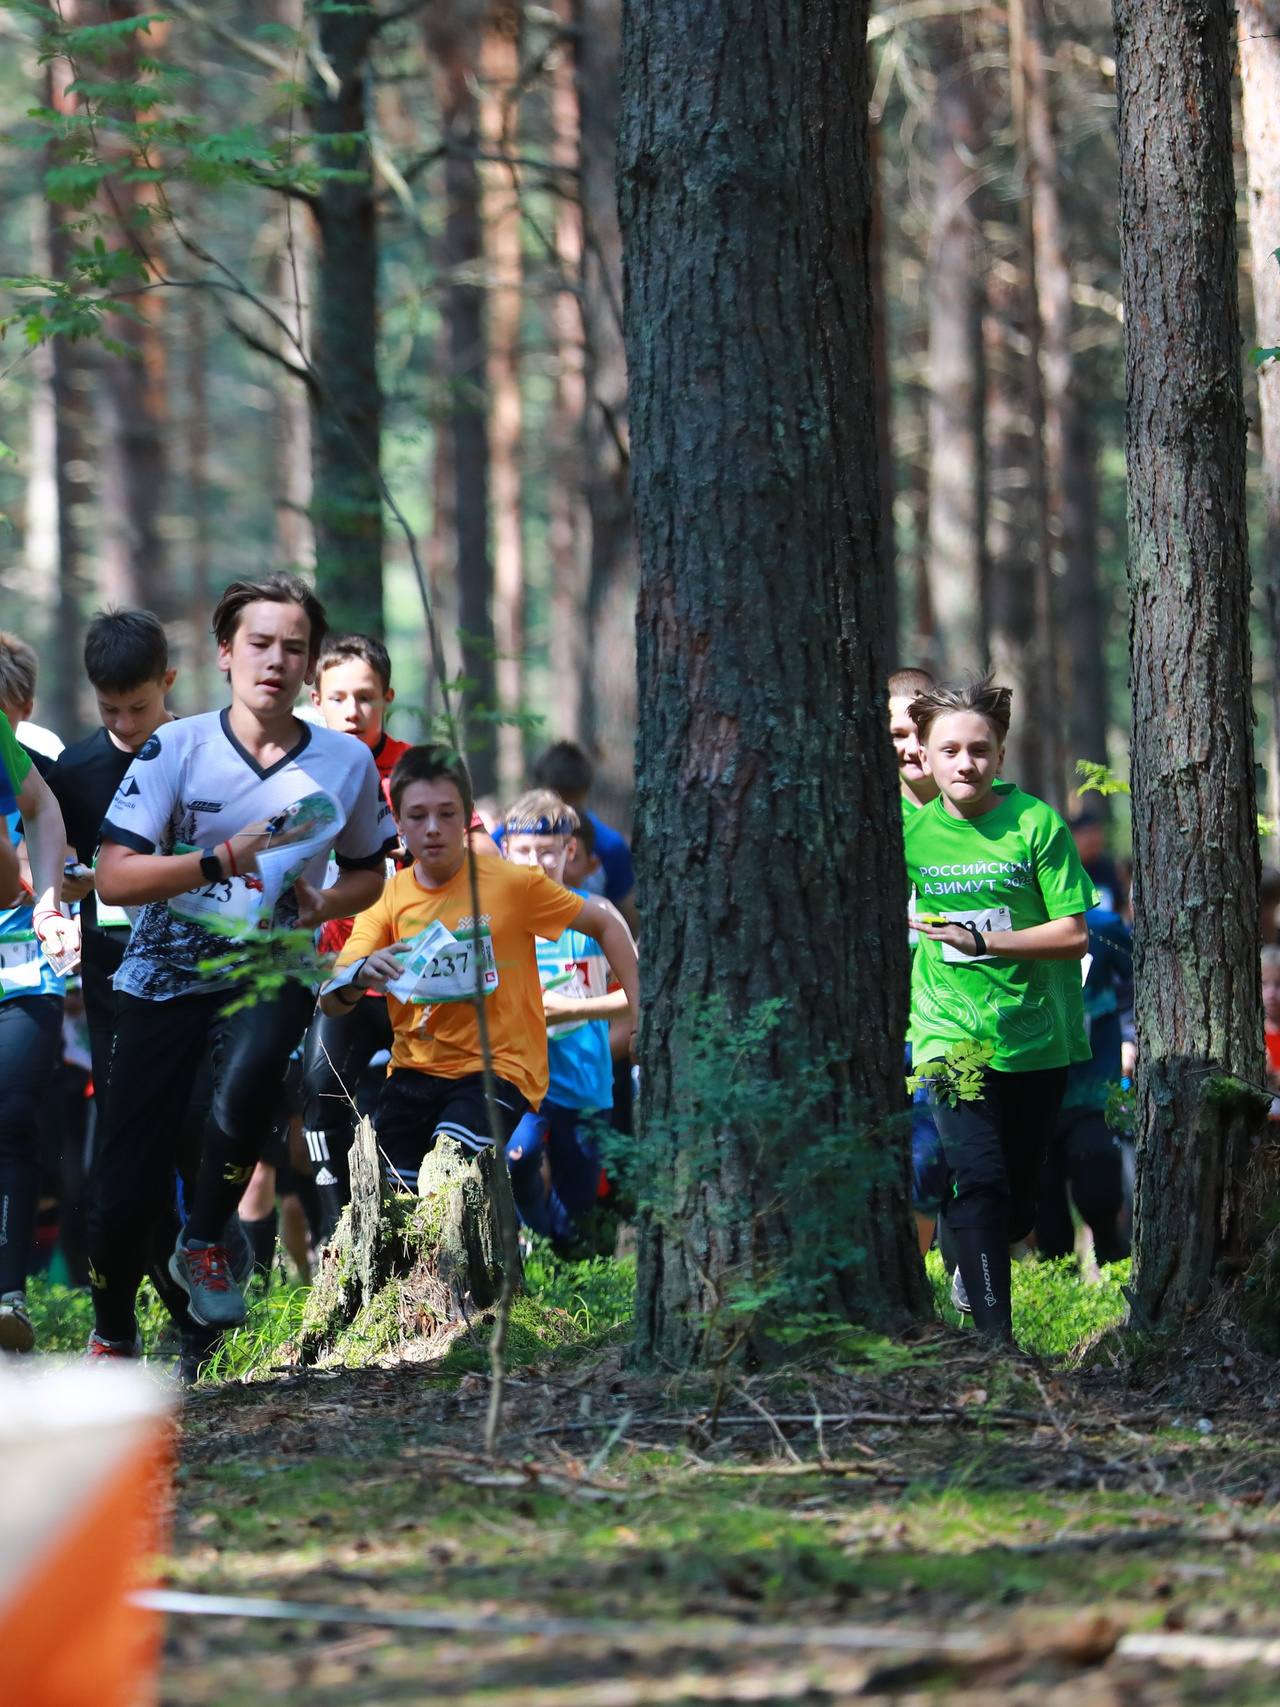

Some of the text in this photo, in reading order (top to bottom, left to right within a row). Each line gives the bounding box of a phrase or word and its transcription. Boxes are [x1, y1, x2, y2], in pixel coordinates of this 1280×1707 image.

[919, 859, 1032, 878] РОССИЙСКИЙ
[924, 879, 997, 895] АЗИМУТ
[422, 952, 468, 978] 237
[981, 1253, 992, 1292] NORD
